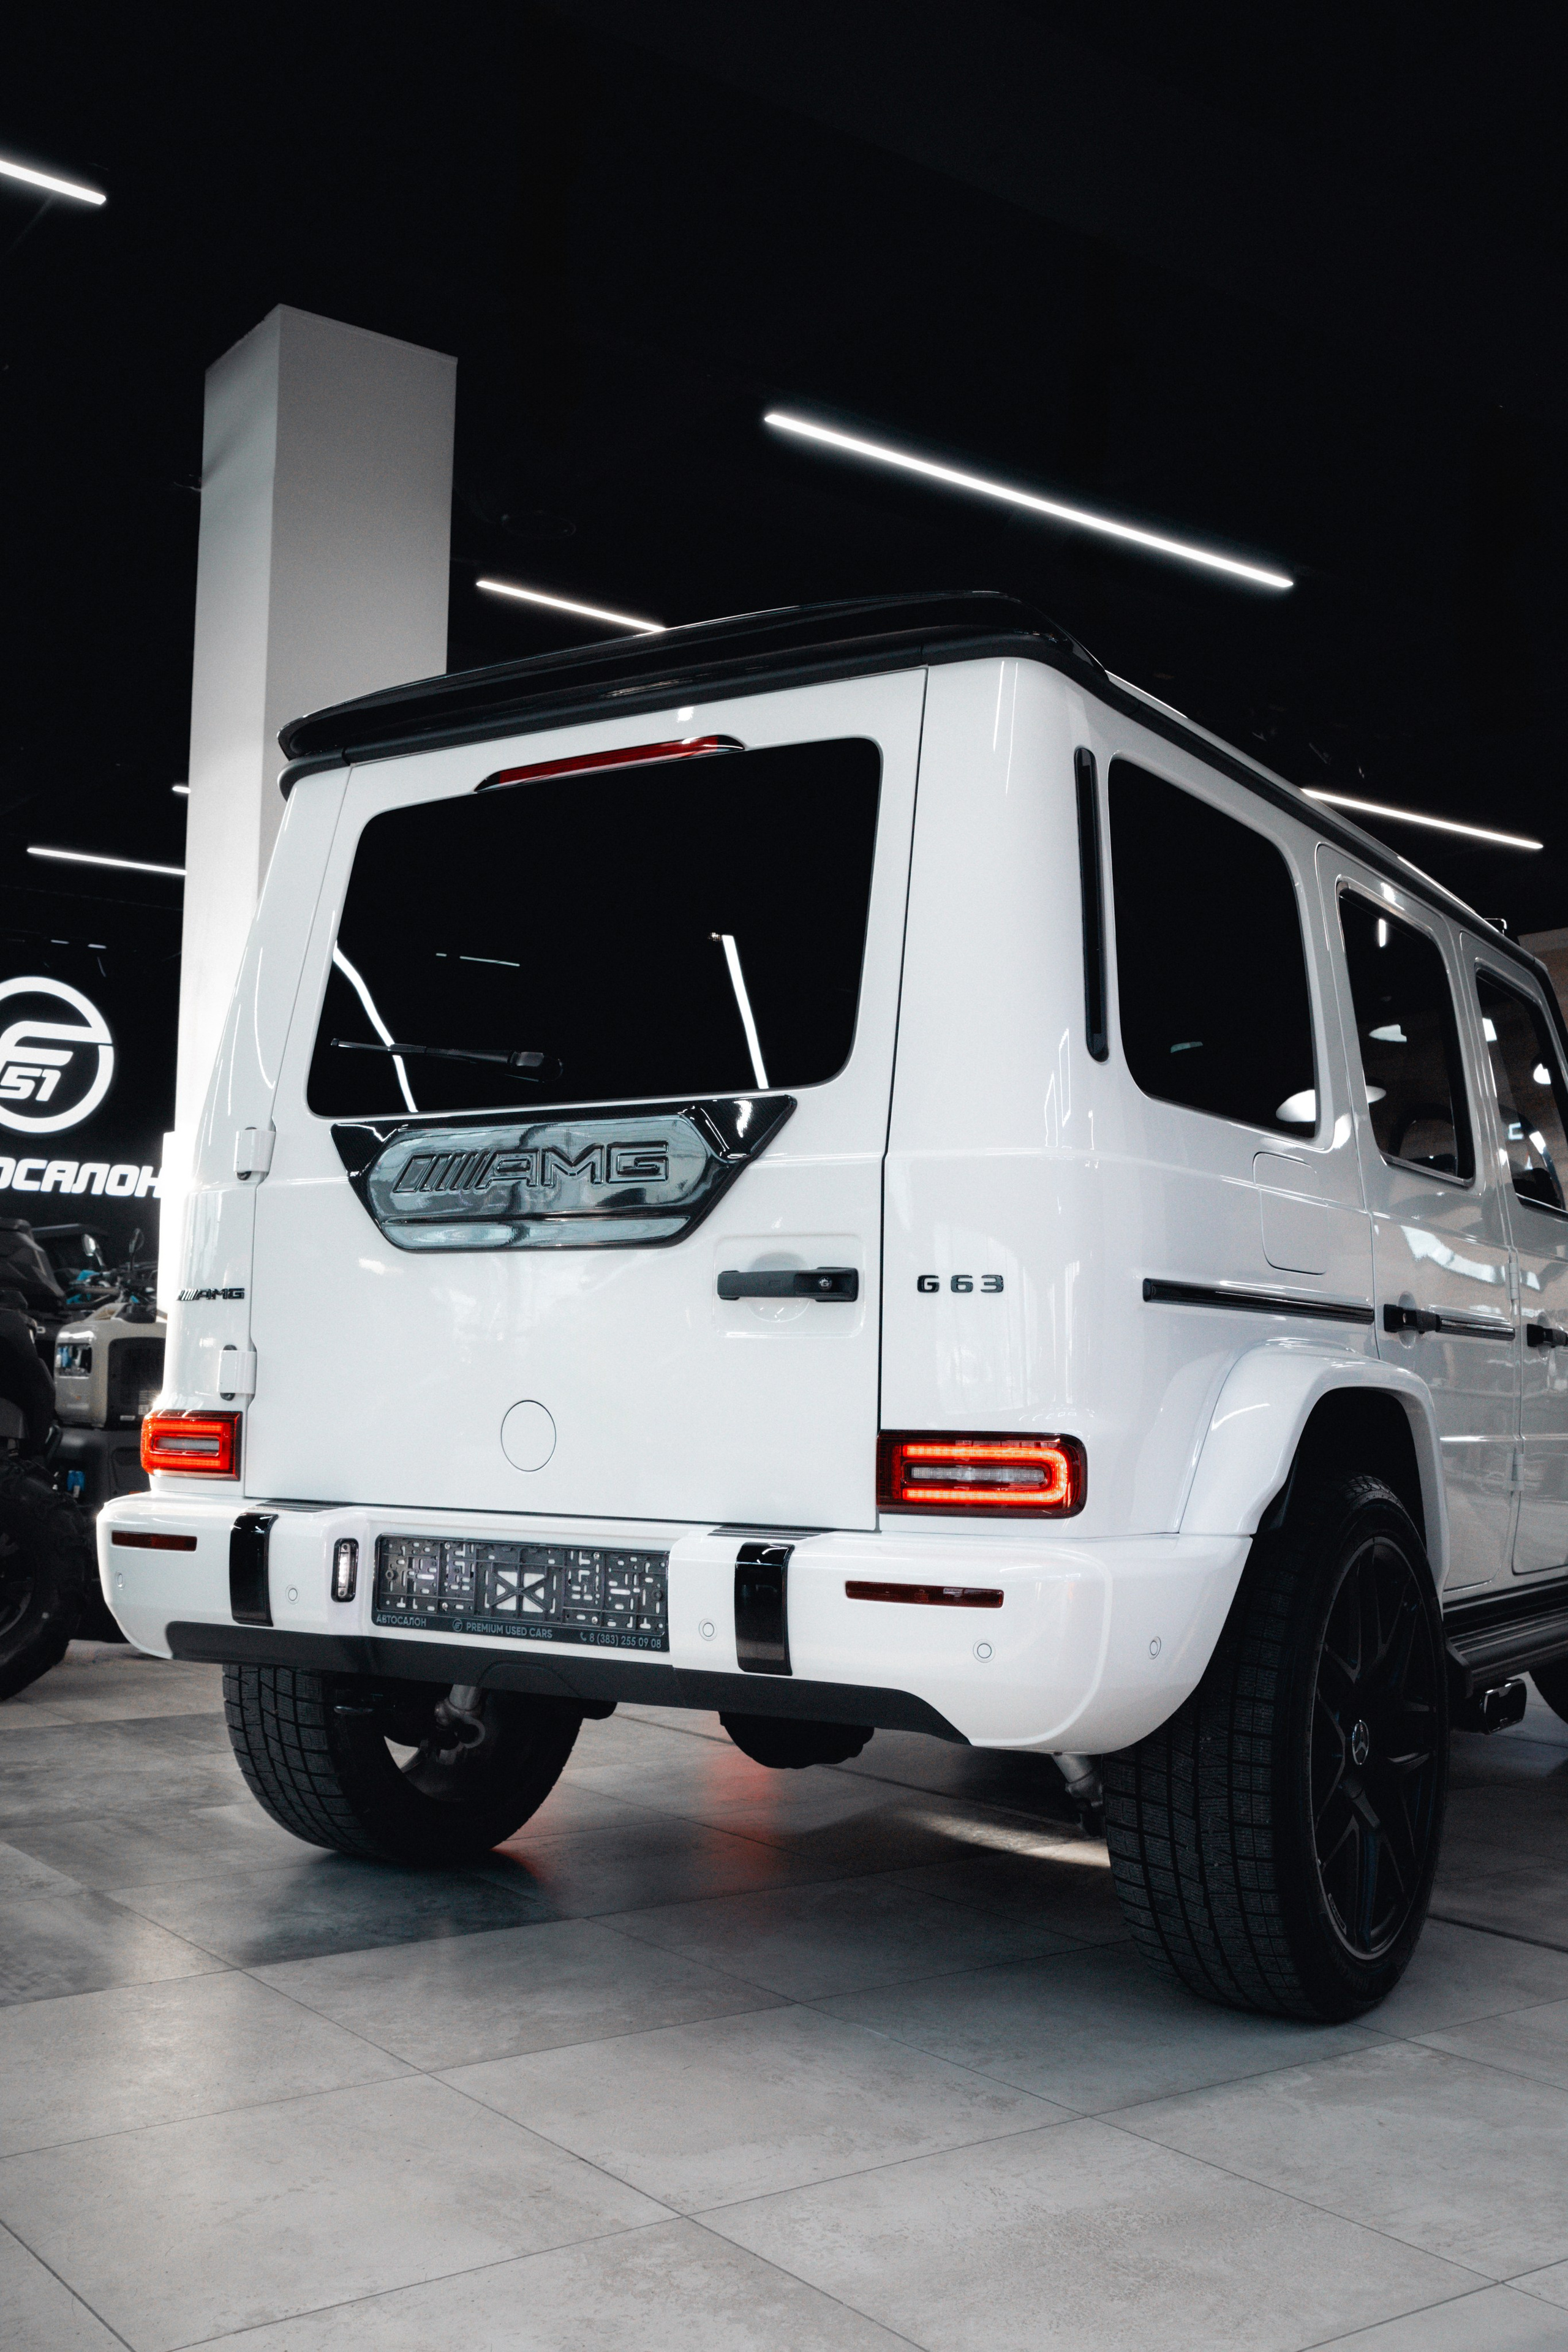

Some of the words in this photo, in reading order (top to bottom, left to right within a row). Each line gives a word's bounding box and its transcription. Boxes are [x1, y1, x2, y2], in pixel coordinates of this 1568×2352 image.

[376, 1614, 427, 1627] АВТОСАЛОН
[466, 1622, 503, 1634] PREMIUM
[505, 1625, 527, 1637] USED
[529, 1627, 553, 1638] CARS
[589, 1633, 595, 1642] 8
[597, 1633, 619, 1646] (383)
[621, 1635, 636, 1646] 255
[638, 1637, 649, 1647] 09
[651, 1638, 662, 1648] 08
